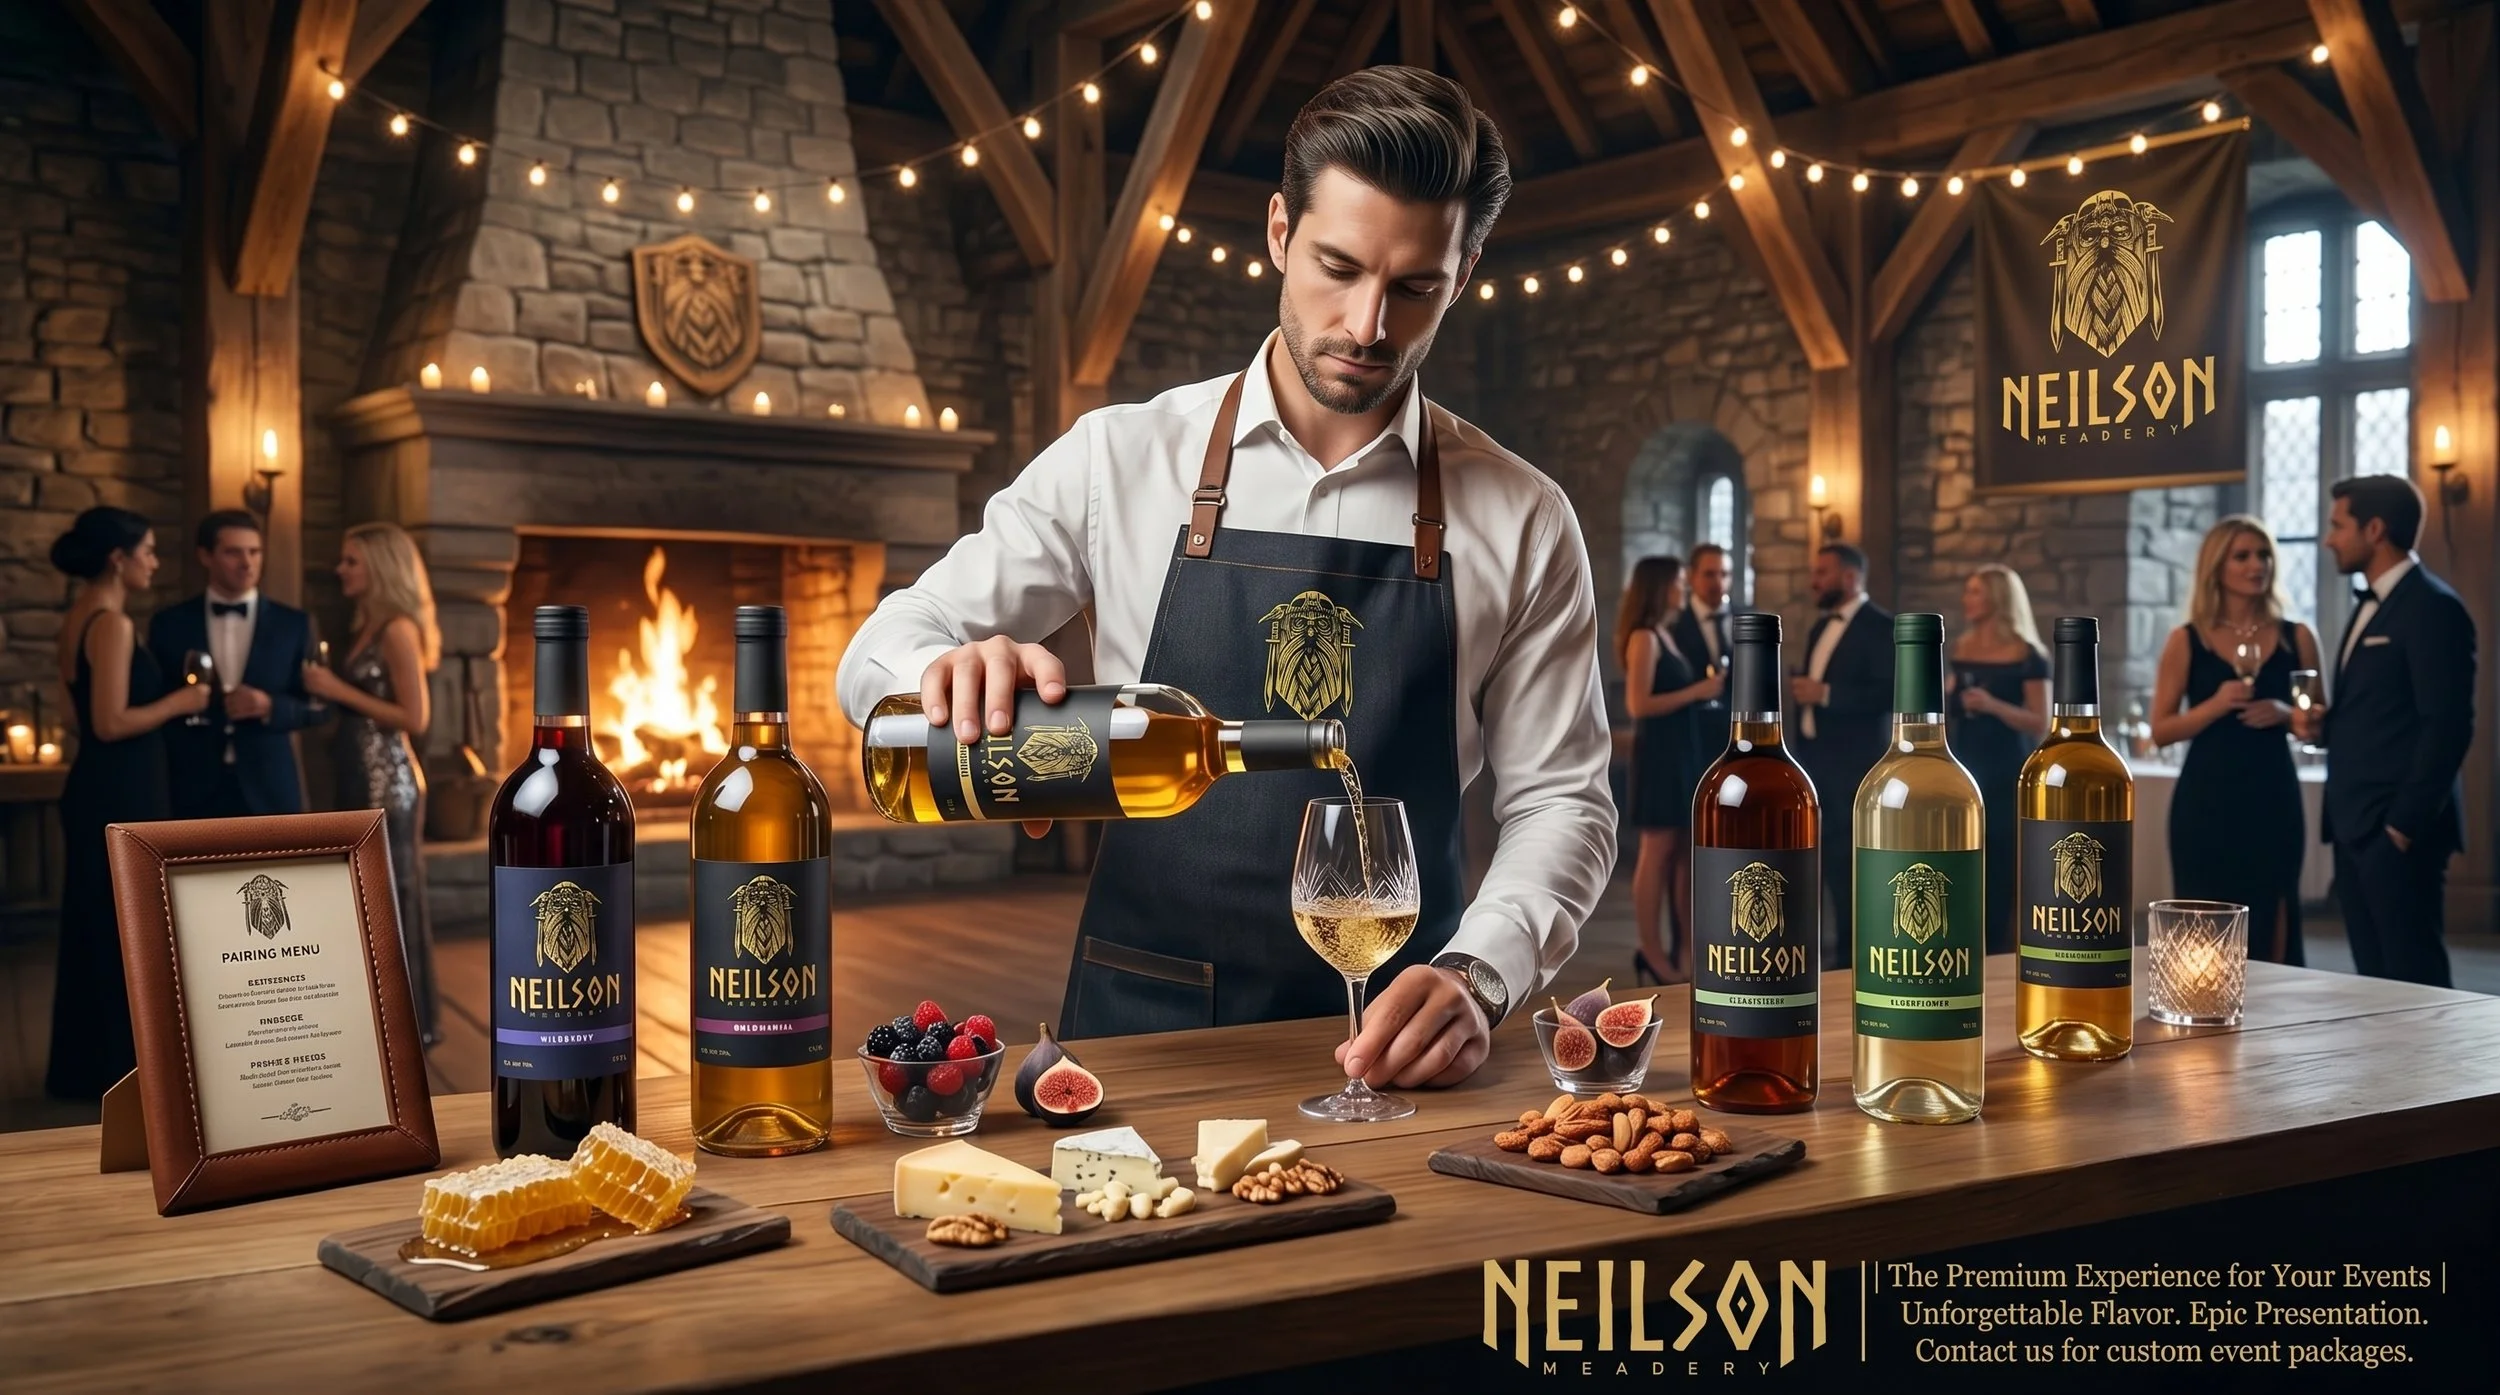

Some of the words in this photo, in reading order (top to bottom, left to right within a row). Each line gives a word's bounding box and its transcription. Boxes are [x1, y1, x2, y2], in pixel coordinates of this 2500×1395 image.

[2002, 356, 2215, 441] NEILSON
[2037, 424, 2180, 446] MEADERY
[987, 734, 1020, 802] ILSON
[2032, 904, 2120, 935] NEILSON
[222, 948, 277, 963] PAIRING
[281, 944, 320, 958] MENU
[1708, 944, 1805, 978] NEILSON
[1870, 945, 1969, 979] NEILSON
[510, 973, 620, 1014] NEILSON
[709, 964, 816, 1003] NEILSON
